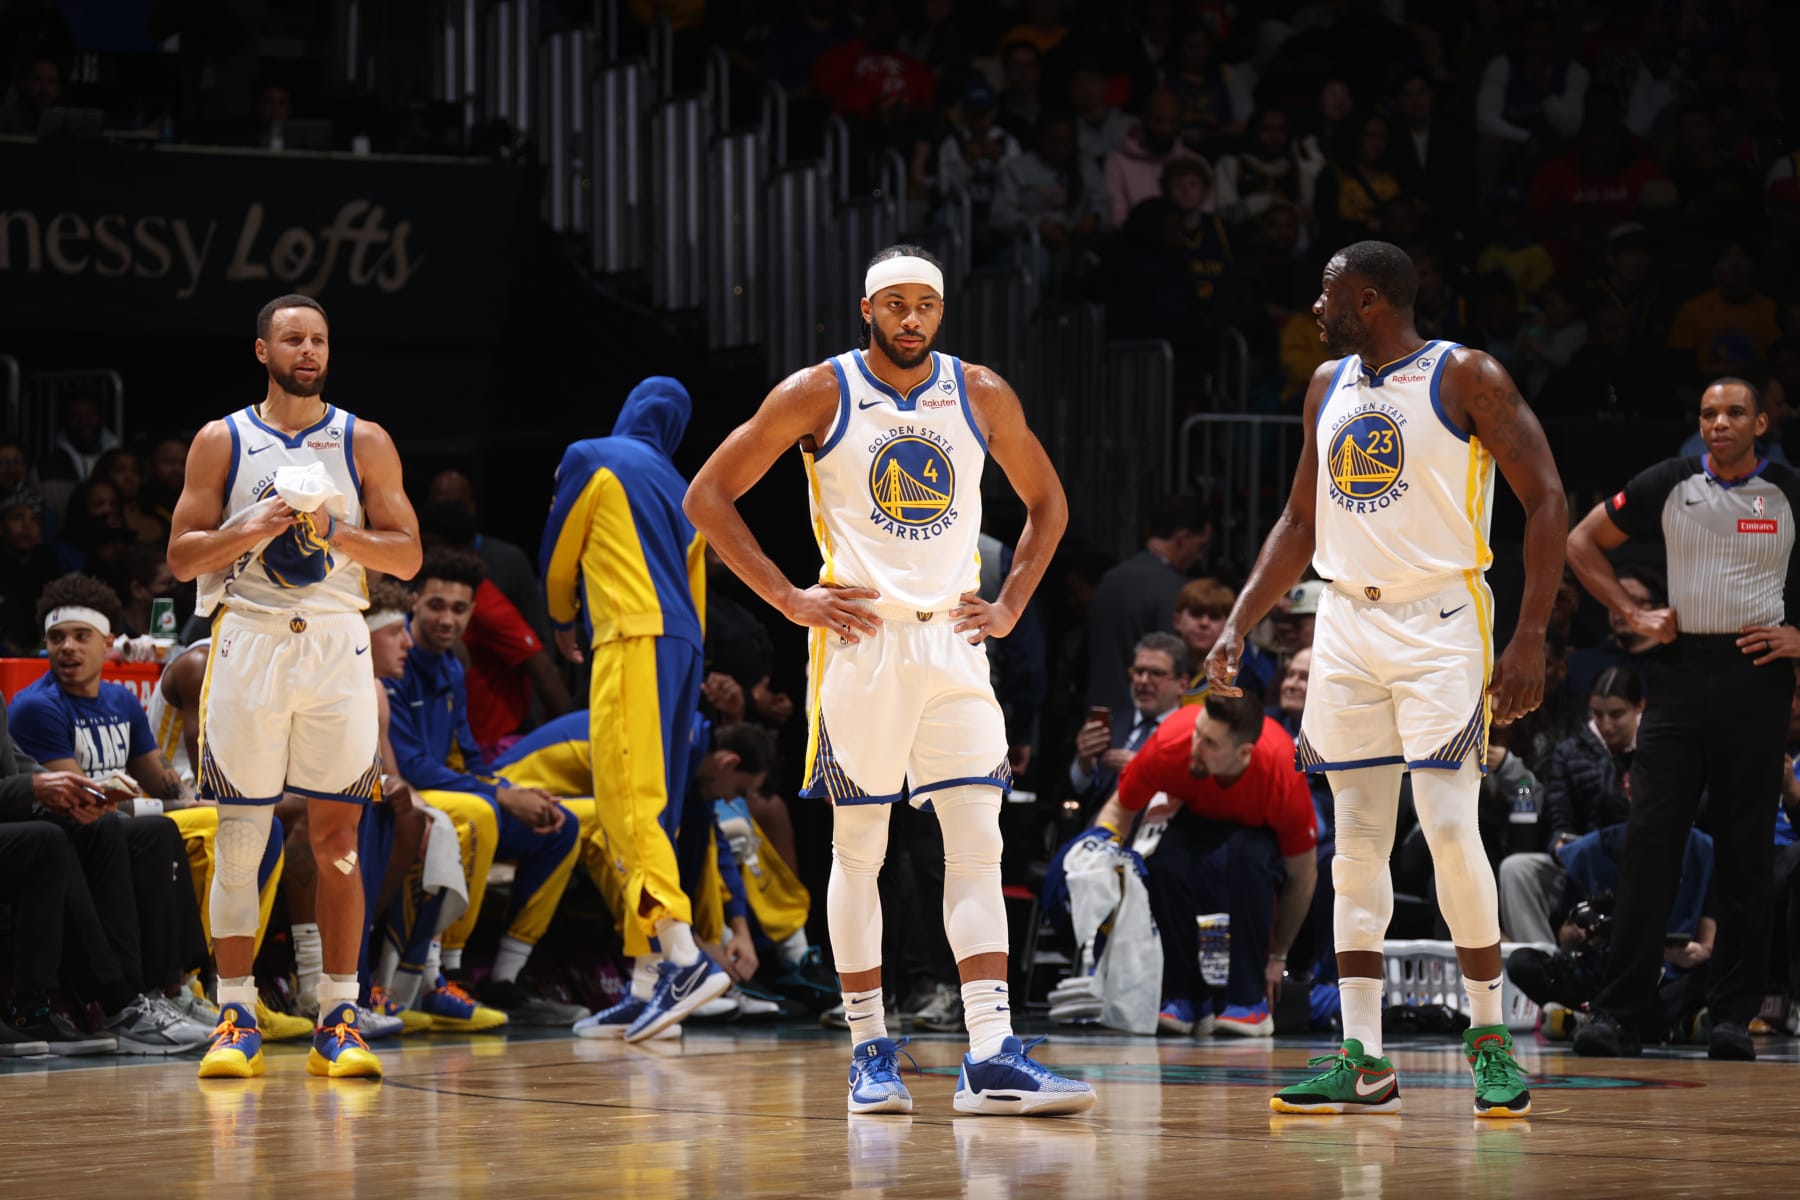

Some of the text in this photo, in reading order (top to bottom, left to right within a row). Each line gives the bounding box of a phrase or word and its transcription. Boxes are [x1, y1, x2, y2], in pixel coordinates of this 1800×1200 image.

[0, 199, 424, 299] nessy Lofts
[1392, 375, 1426, 383] Rakuten
[922, 399, 956, 409] Rakuten
[1331, 402, 1408, 431] GOLDEN STATE
[307, 441, 340, 450] Rakuten
[868, 425, 954, 454] GOLDEN STATE
[1366, 429, 1394, 454] 23
[923, 458, 938, 483] 4
[1329, 480, 1409, 514] WARRIORS
[870, 507, 958, 540] WARRIORS
[1741, 522, 1774, 531] Emirates
